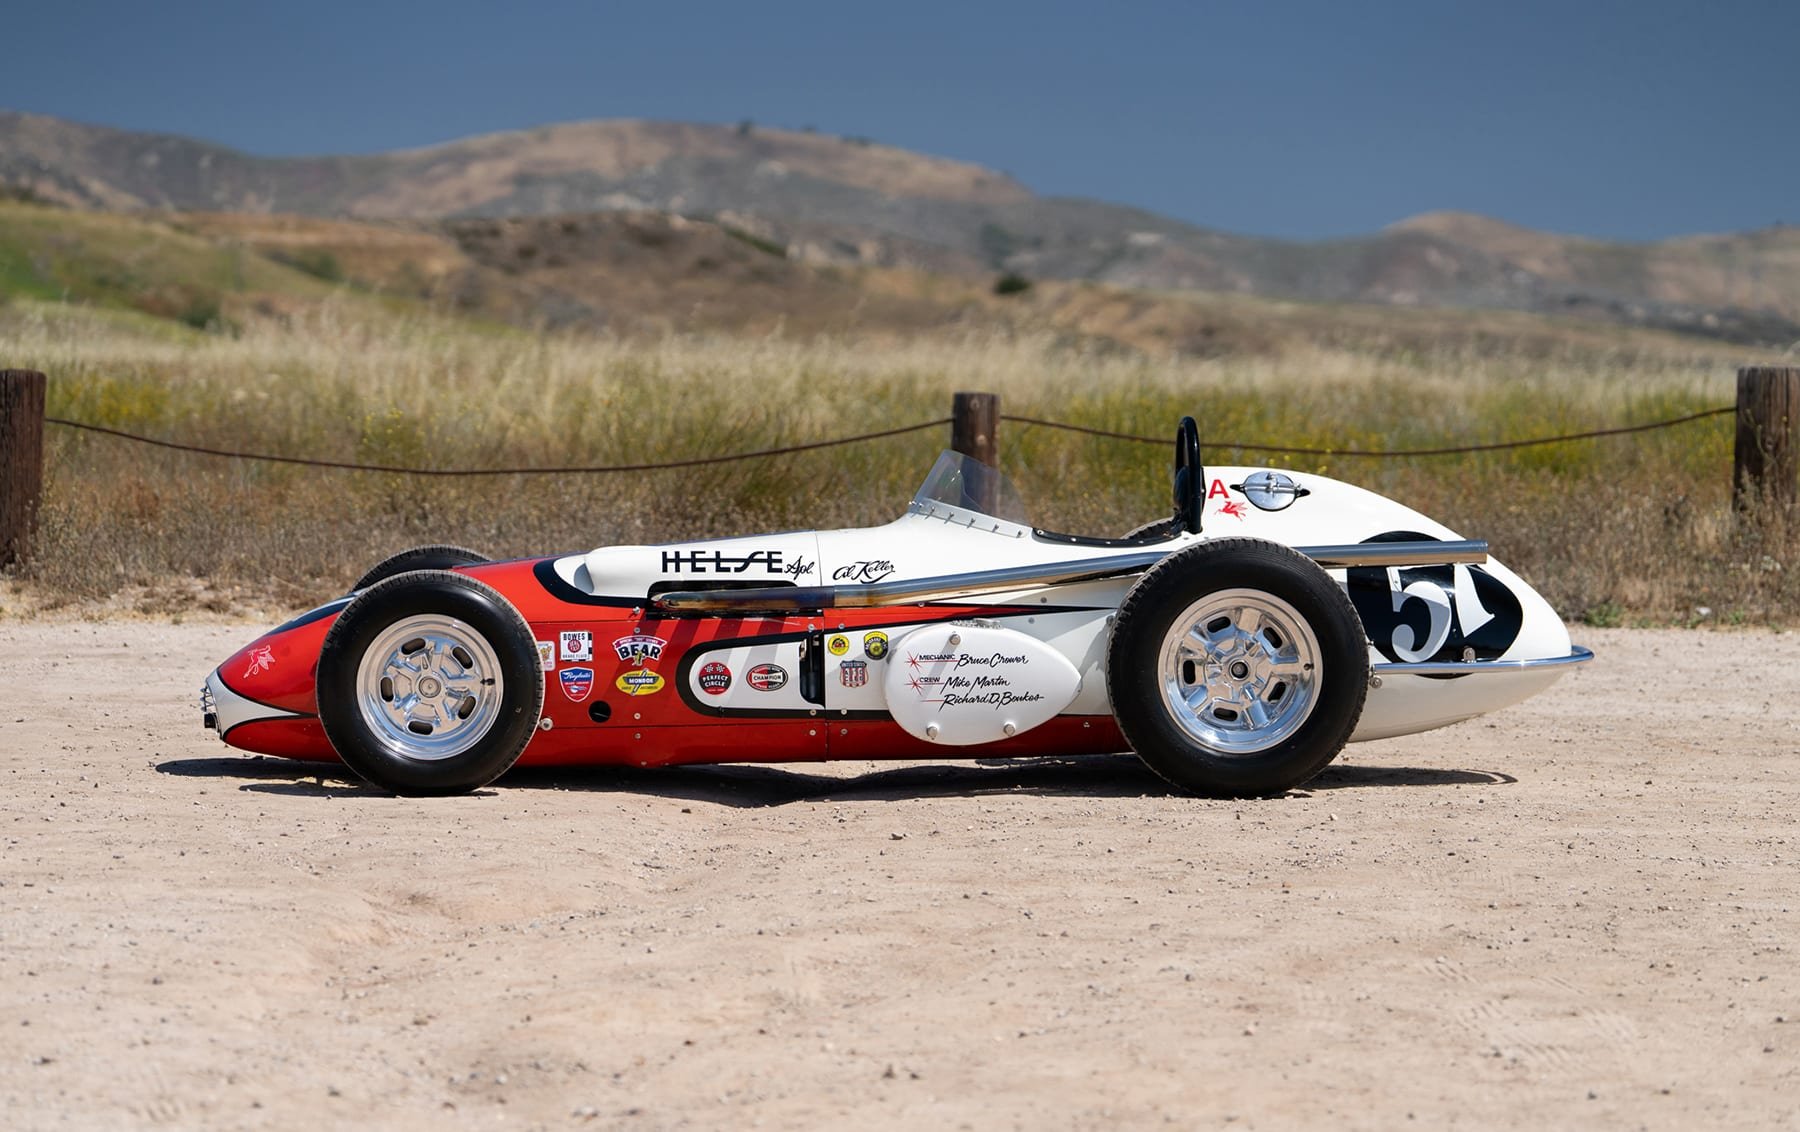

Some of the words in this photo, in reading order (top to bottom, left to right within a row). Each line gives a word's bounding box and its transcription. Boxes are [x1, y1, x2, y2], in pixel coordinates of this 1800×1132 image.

[1208, 479, 1230, 499] A
[662, 550, 783, 573] HELSE
[832, 564, 857, 581] Al
[851, 560, 896, 585] Keller
[563, 632, 586, 641] BOWES
[617, 644, 661, 659] BEAR
[918, 653, 956, 661] MECHANIC
[954, 653, 990, 671] Bruce
[989, 652, 1030, 668] Crower
[702, 674, 729, 682] PERFECT
[704, 680, 726, 688] CIRCLE
[753, 673, 783, 682] CHAMPION
[939, 676, 971, 695] Mike
[967, 675, 1011, 696] Martin
[938, 692, 989, 712] Richard
